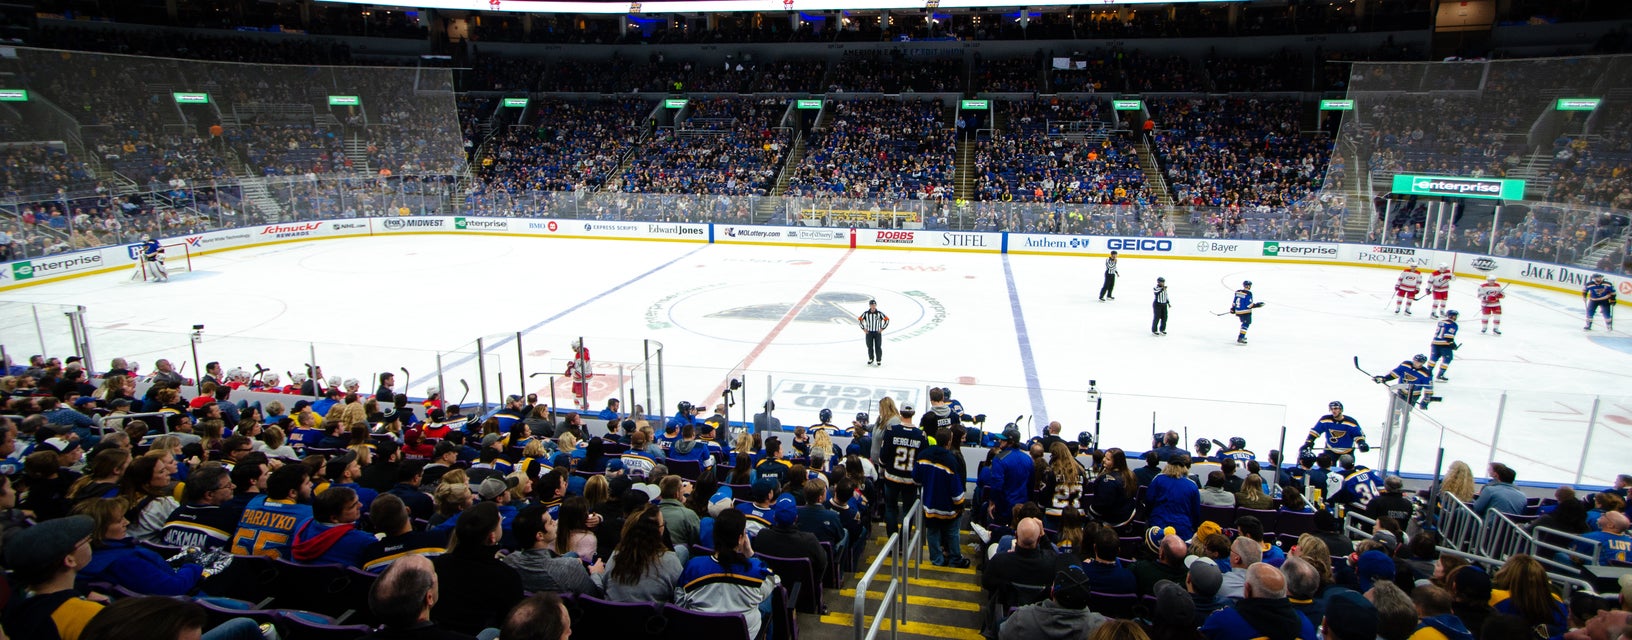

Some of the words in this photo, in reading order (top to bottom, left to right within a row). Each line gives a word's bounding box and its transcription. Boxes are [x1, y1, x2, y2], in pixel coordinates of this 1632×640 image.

[1415, 180, 1500, 193] enterprise
[260, 222, 324, 235] Schnucks
[406, 219, 444, 227] MIDWEST
[456, 218, 507, 229] enterprise
[648, 224, 678, 234] Edward
[679, 226, 704, 235] Jones
[877, 231, 914, 240] DOBBS
[942, 232, 987, 247] STIFEL
[1024, 237, 1067, 248] Anthem
[1107, 239, 1172, 251] GEICO
[1211, 243, 1239, 252] Bayer
[1266, 244, 1337, 256] enterprise
[15, 254, 101, 275] enterprise
[1521, 263, 1554, 280] JACK
[783, 382, 911, 401] LIGHT
[893, 437, 921, 448] BERGLUND
[893, 446, 916, 471] 21
[241, 509, 296, 531] PARAYKO
[231, 527, 288, 560] 55
